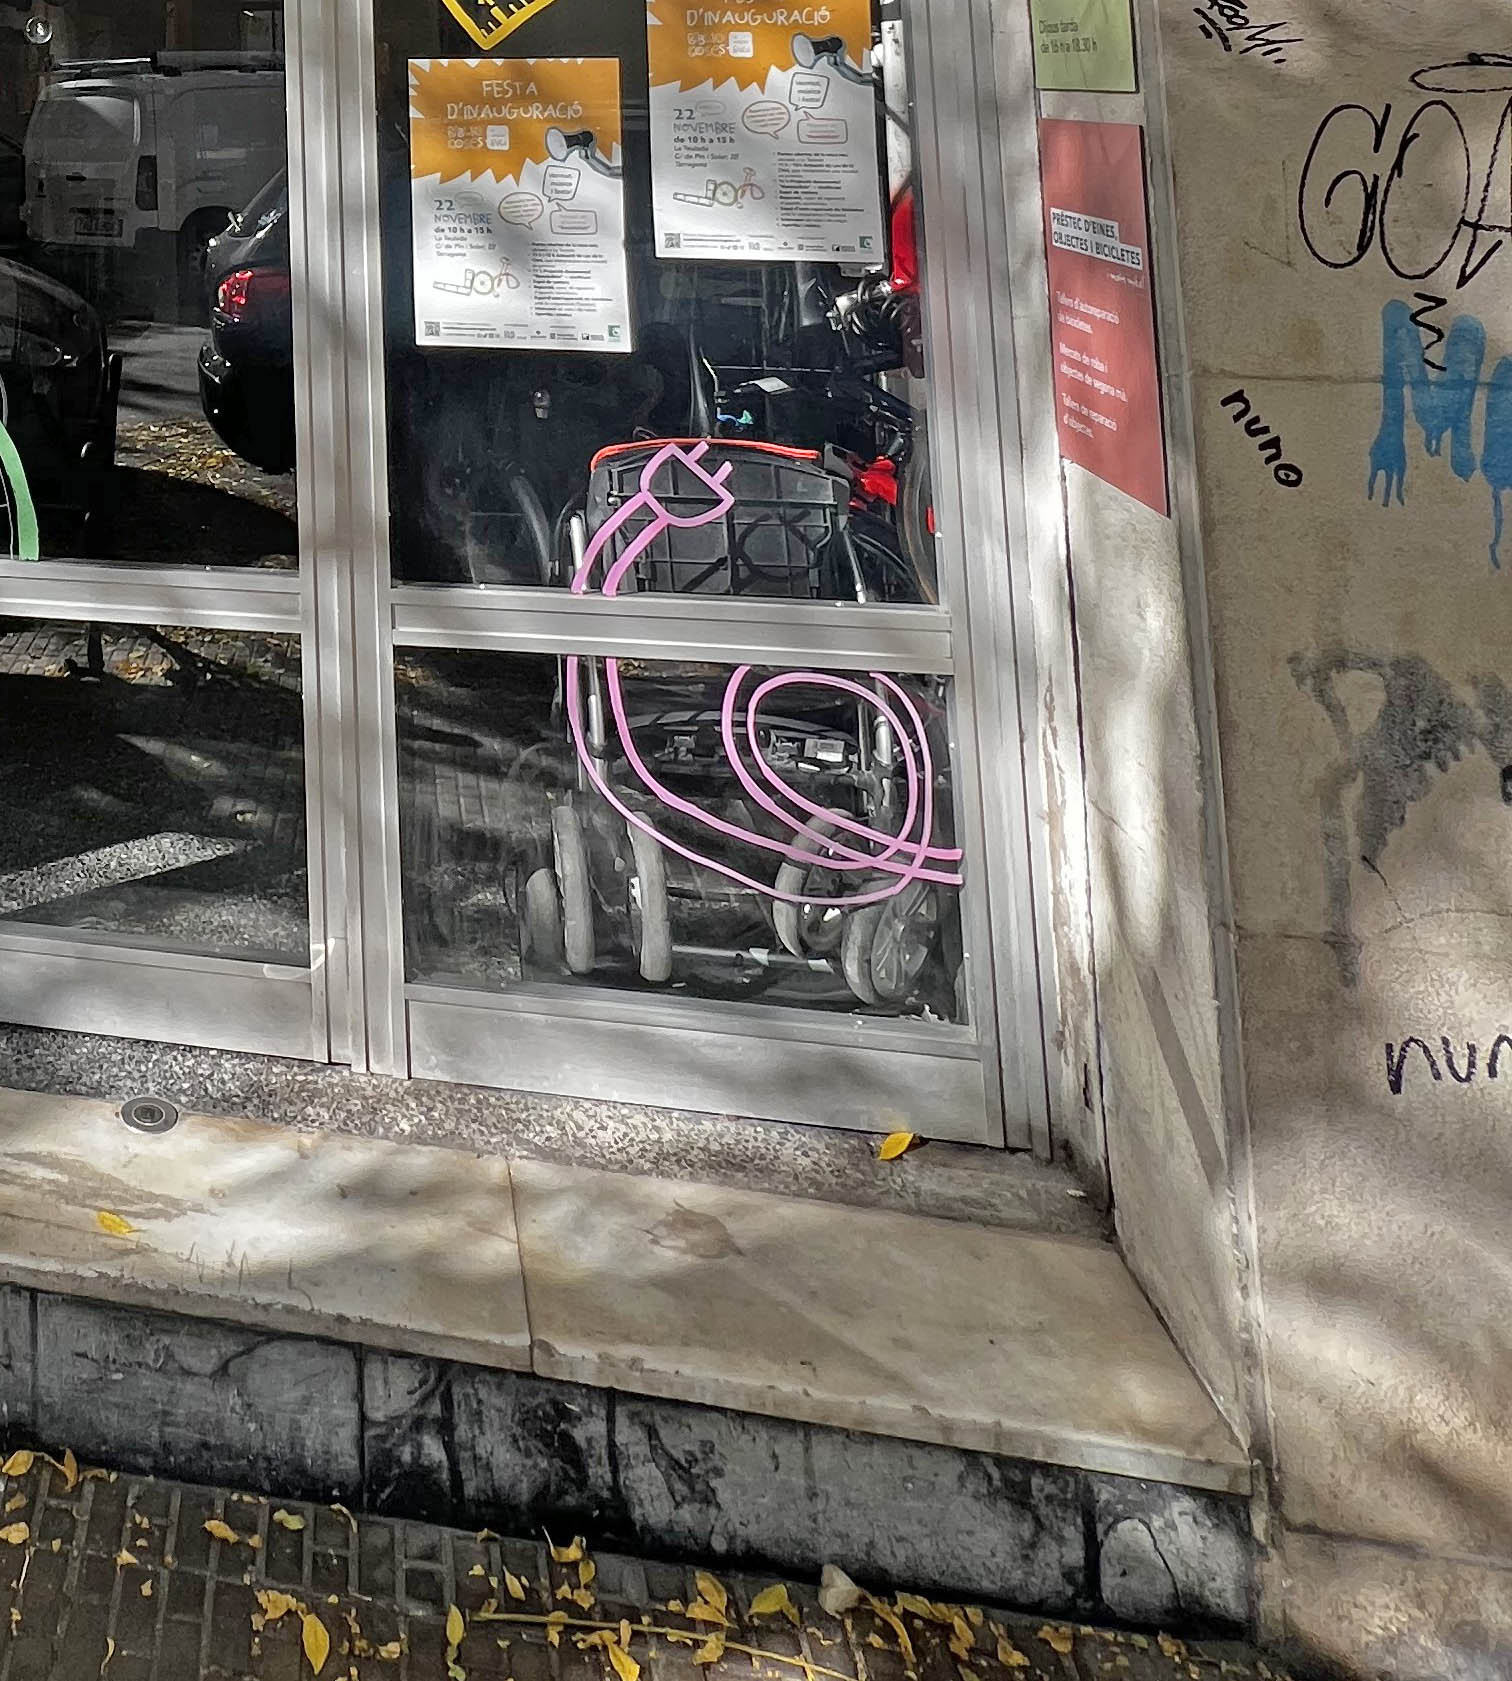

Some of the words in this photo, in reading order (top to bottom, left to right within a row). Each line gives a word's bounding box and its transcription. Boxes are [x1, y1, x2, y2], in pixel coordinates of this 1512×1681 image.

[687, 6, 831, 26] D'INAUGURACIÓ
[482, 80, 538, 97] FESTA
[447, 102, 583, 120] D'INAUGURACIÓ
[673, 108, 695, 120] 22
[673, 121, 736, 134] NOVEMBRE
[434, 200, 455, 210] 22
[434, 213, 493, 225] NOVEMBRE
[1052, 211, 1082, 231] PRÉSTEC
[1053, 231, 1089, 252] OBJECTES
[1096, 241, 1141, 266] BICICLETES
[1220, 389, 1303, 488] nuno
